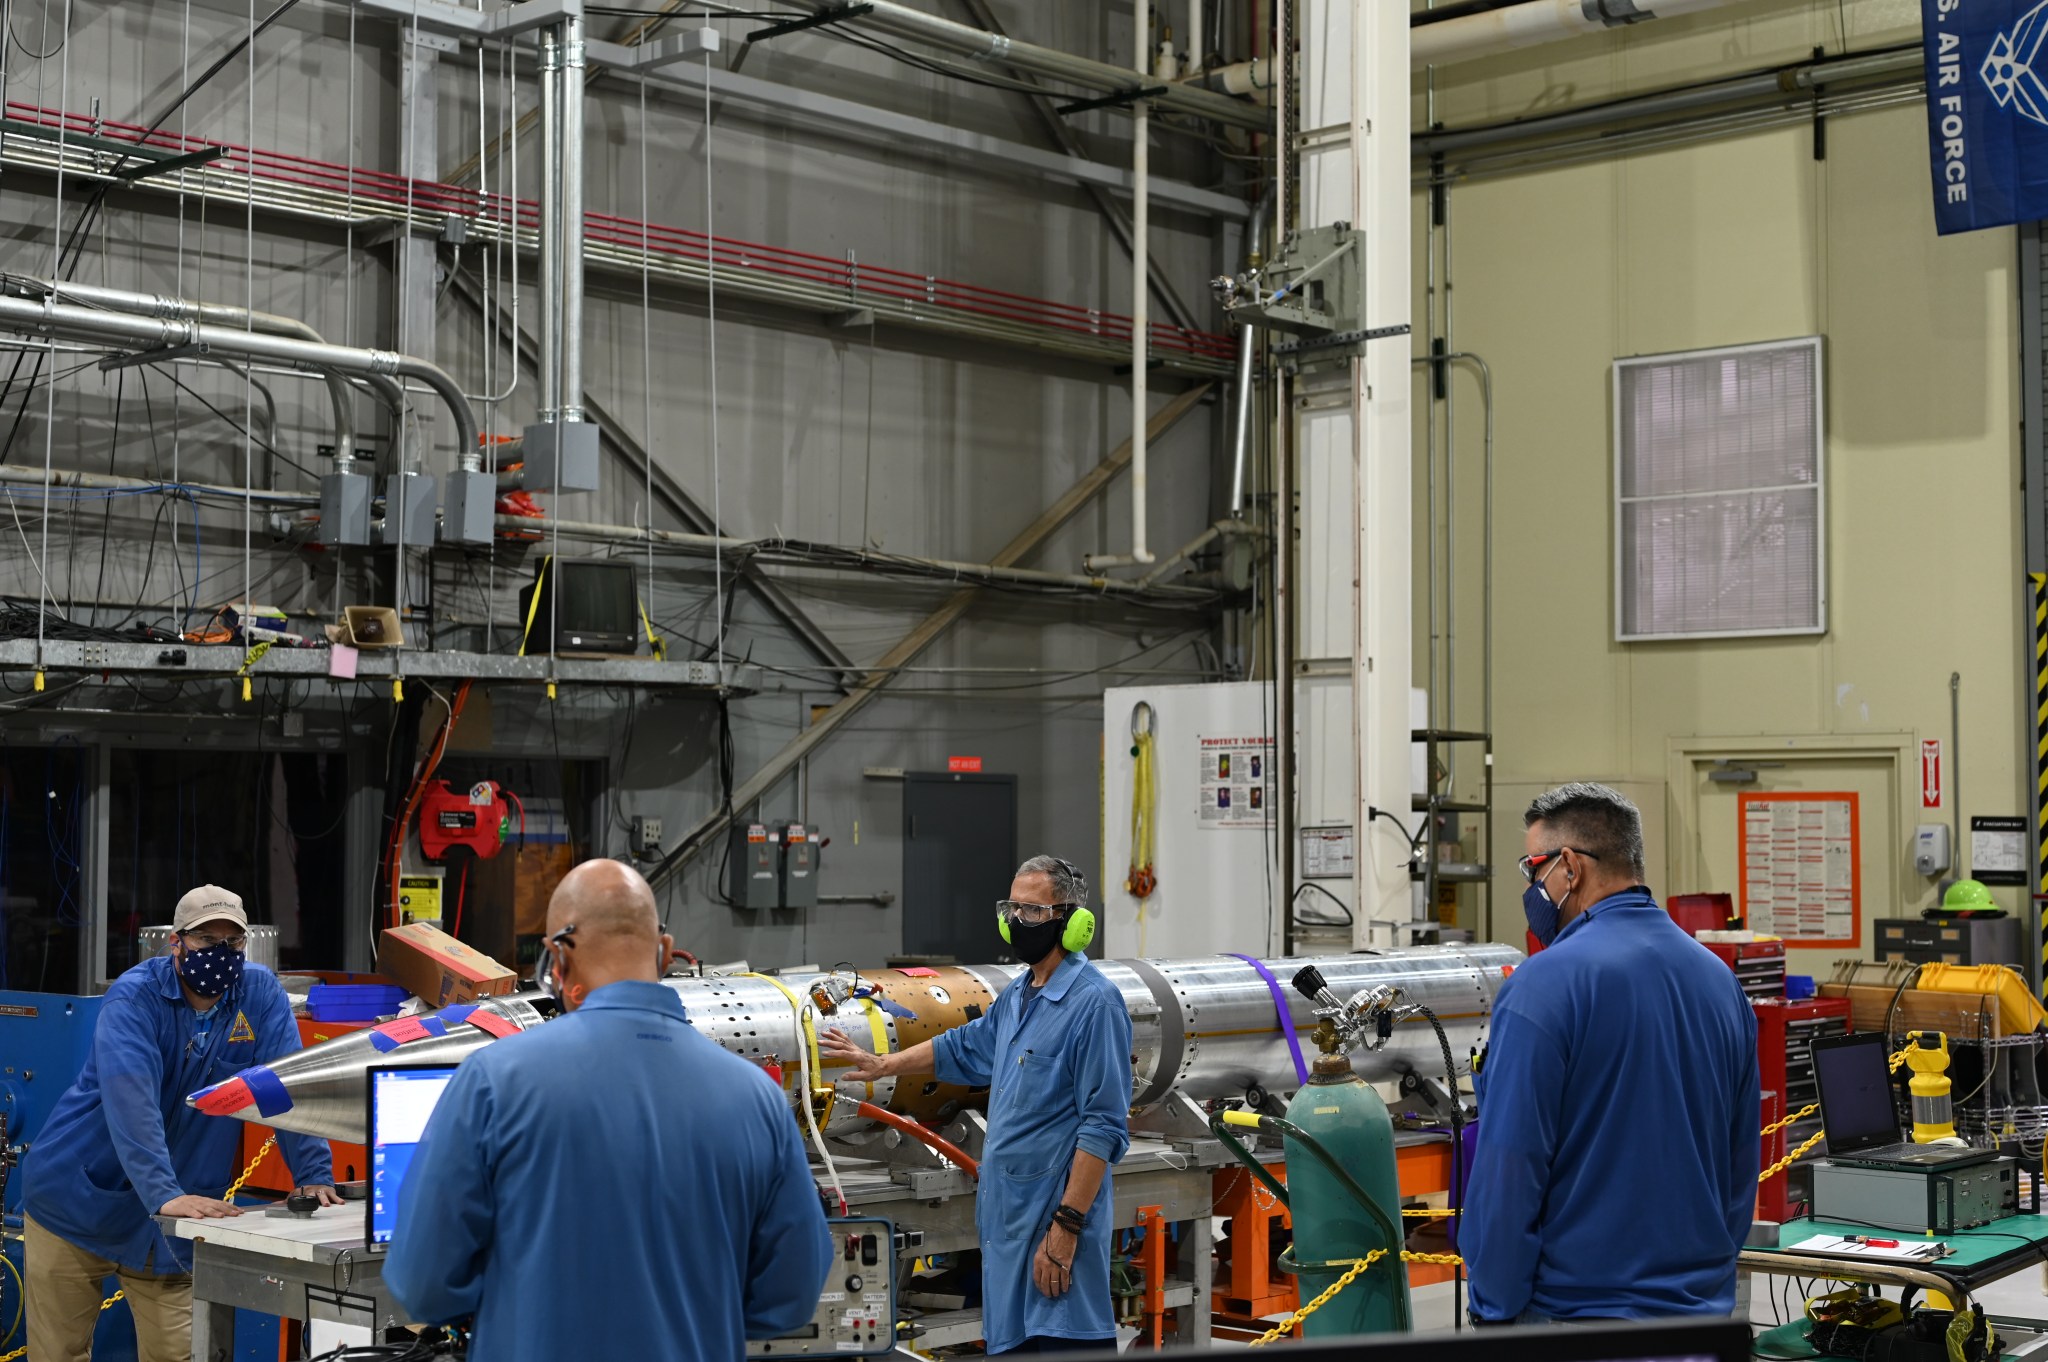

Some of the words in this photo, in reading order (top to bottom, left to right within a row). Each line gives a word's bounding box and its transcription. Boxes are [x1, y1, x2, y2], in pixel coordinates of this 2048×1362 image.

[1937, 32, 1961, 88] AIR
[1940, 95, 1967, 204] FORCE
[1201, 737, 1239, 746] PROTECT
[392, 1025, 426, 1039] Caution
[222, 1095, 245, 1109] REMOVE
